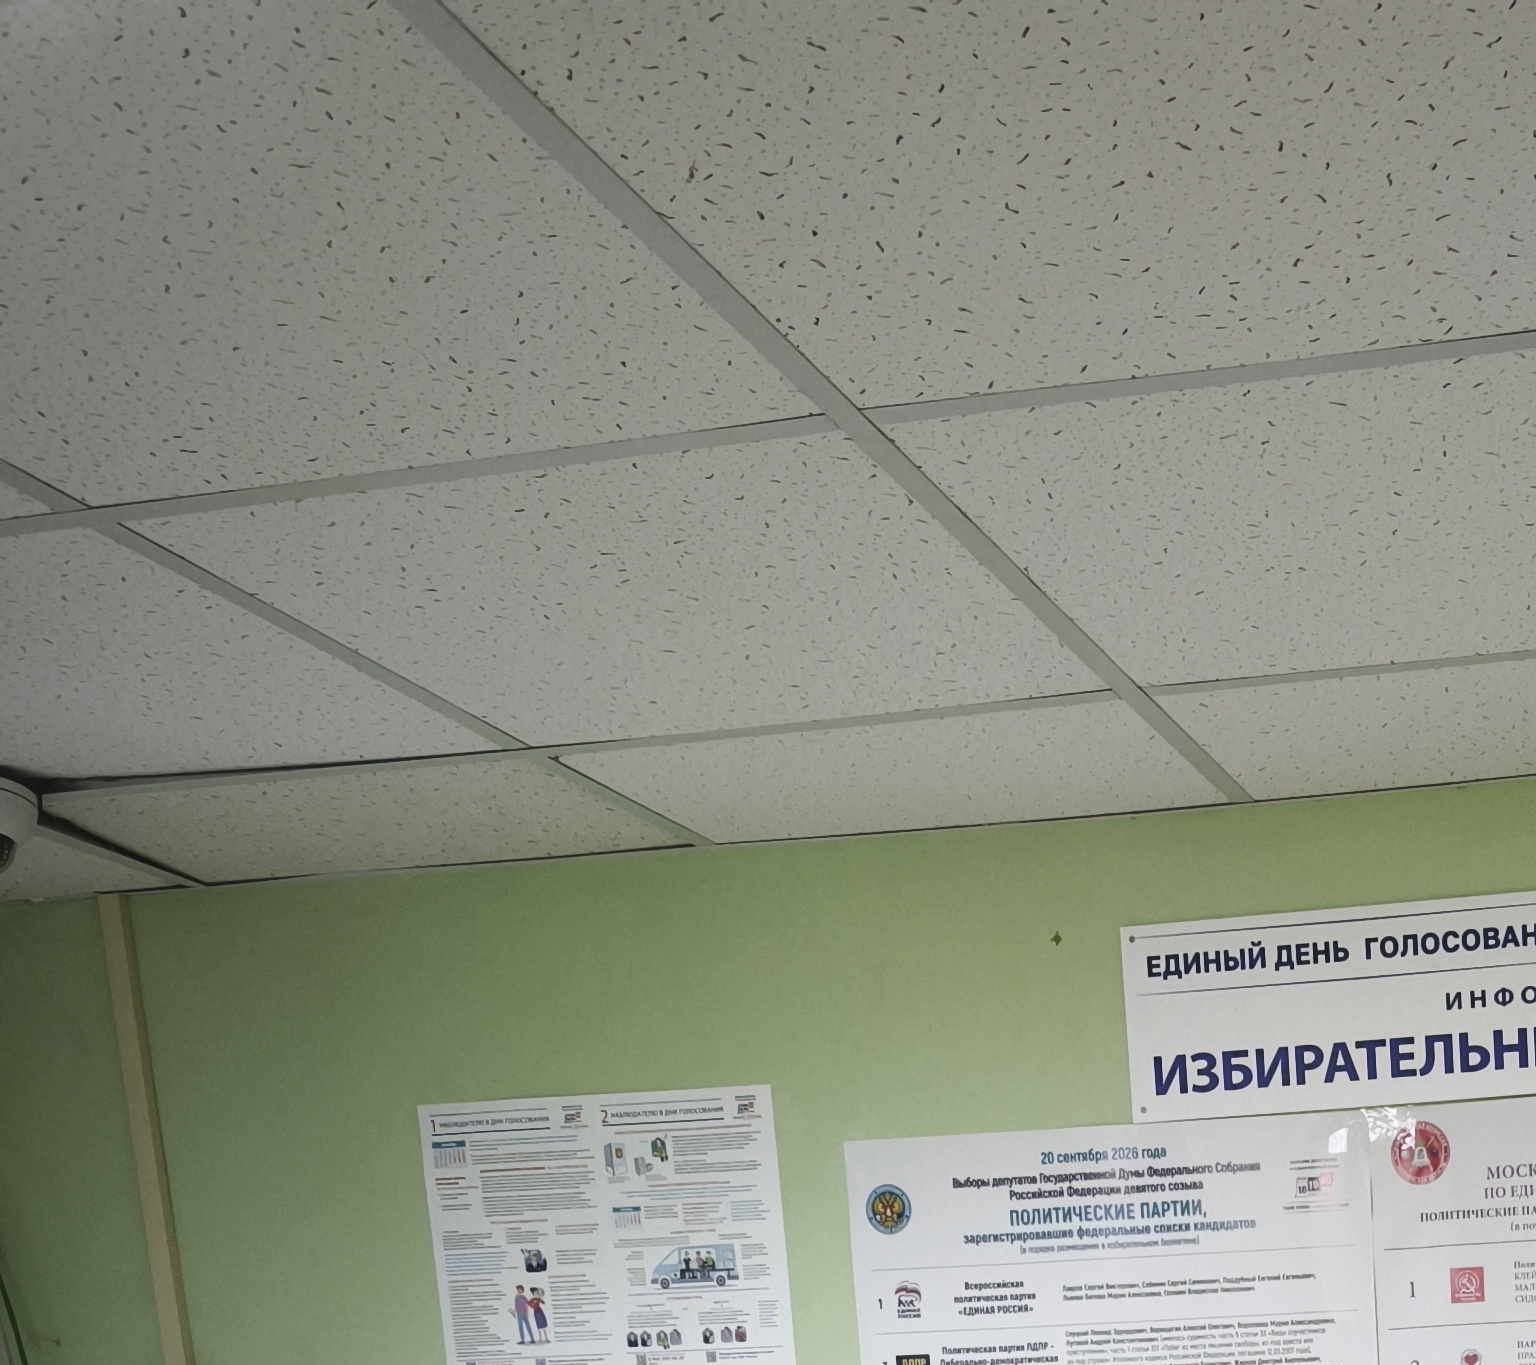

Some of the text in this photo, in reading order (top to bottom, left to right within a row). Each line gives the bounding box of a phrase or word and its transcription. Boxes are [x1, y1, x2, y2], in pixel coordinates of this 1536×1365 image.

[1146, 941, 1266, 979] ЕДИНЫЙ
[1274, 940, 1349, 970] ДЕНЬ
[1040, 1146, 1166, 1164] 20 сентября 2026 года
[1484, 1186, 1506, 1199] ПО
[1009, 1199, 1206, 1225] ПОЛИТИЧЕСКИЕ ПАРТИИ,
[1420, 1206, 1519, 1221] ПОЛИТИЧЕСКИЕ
[1409, 1281, 1415, 1297] 1
